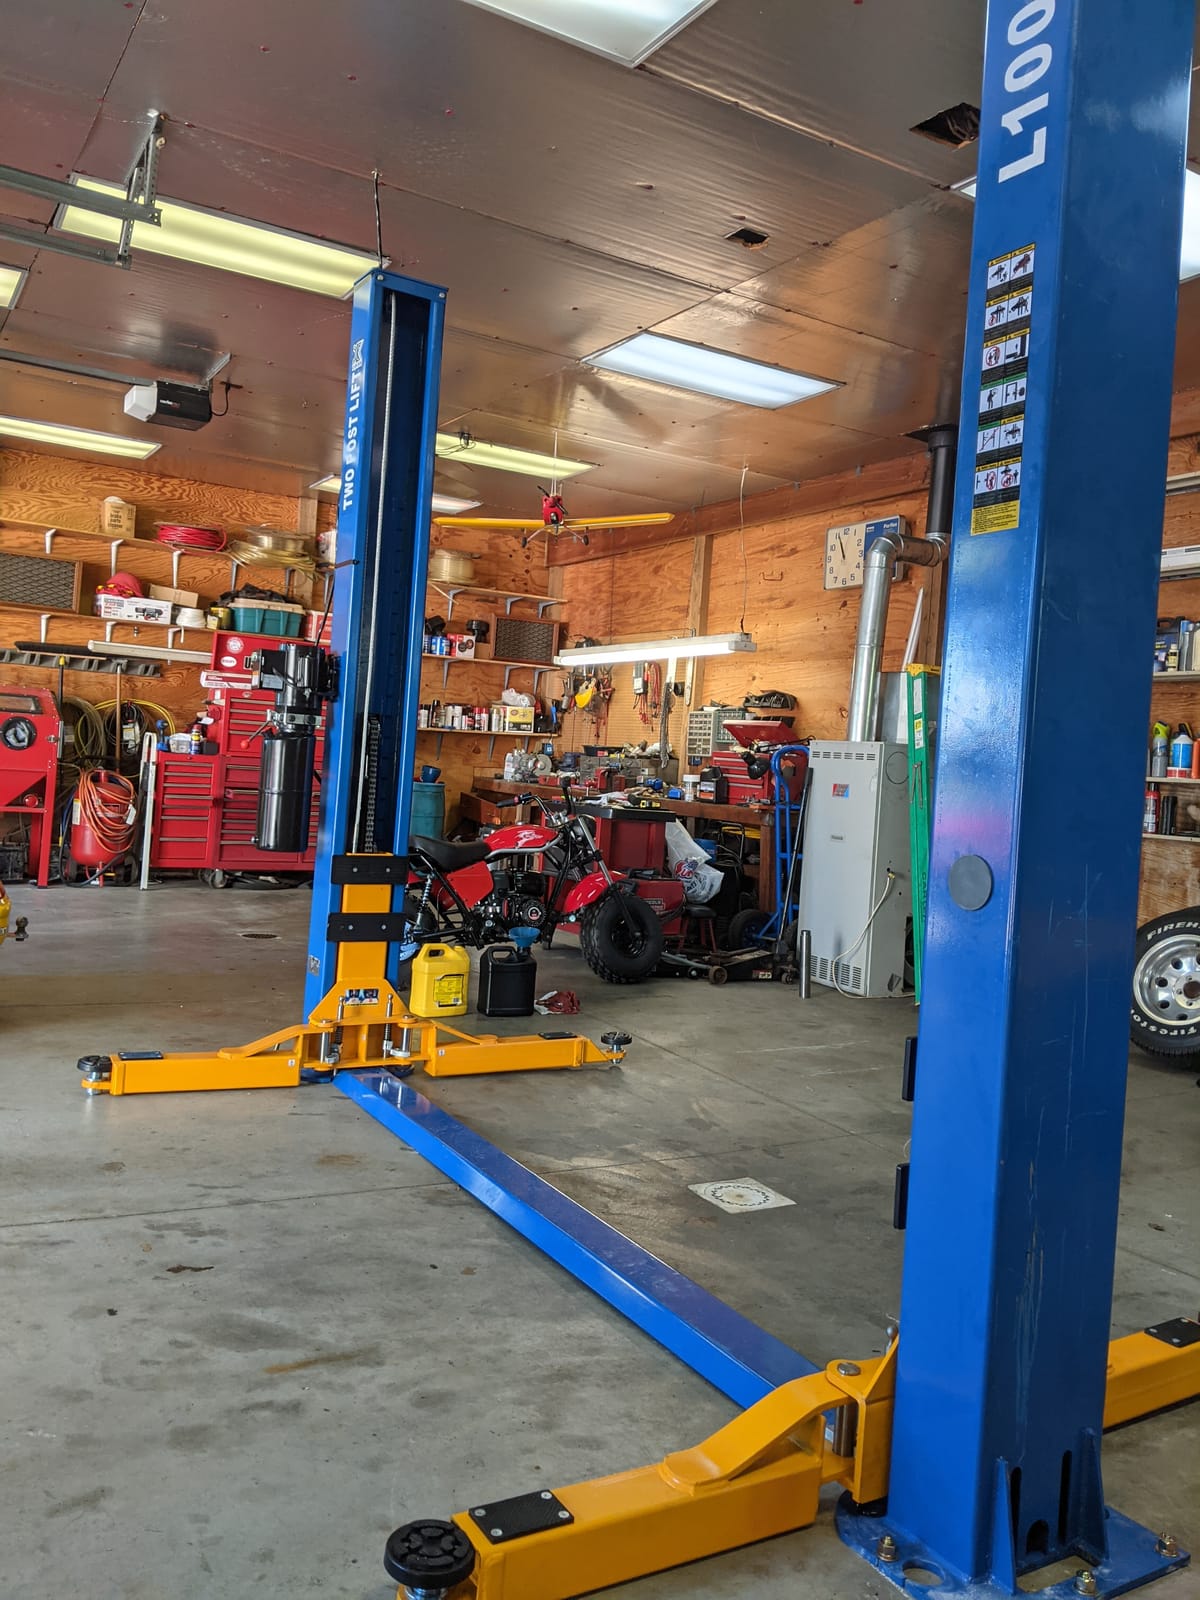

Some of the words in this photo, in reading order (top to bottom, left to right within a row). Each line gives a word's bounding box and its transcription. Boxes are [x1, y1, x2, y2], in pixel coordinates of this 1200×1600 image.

[350, 371, 361, 413] LIFT
[345, 417, 358, 465] POST
[343, 468, 355, 510] TWO
[1146, 921, 1200, 941] FIREH
